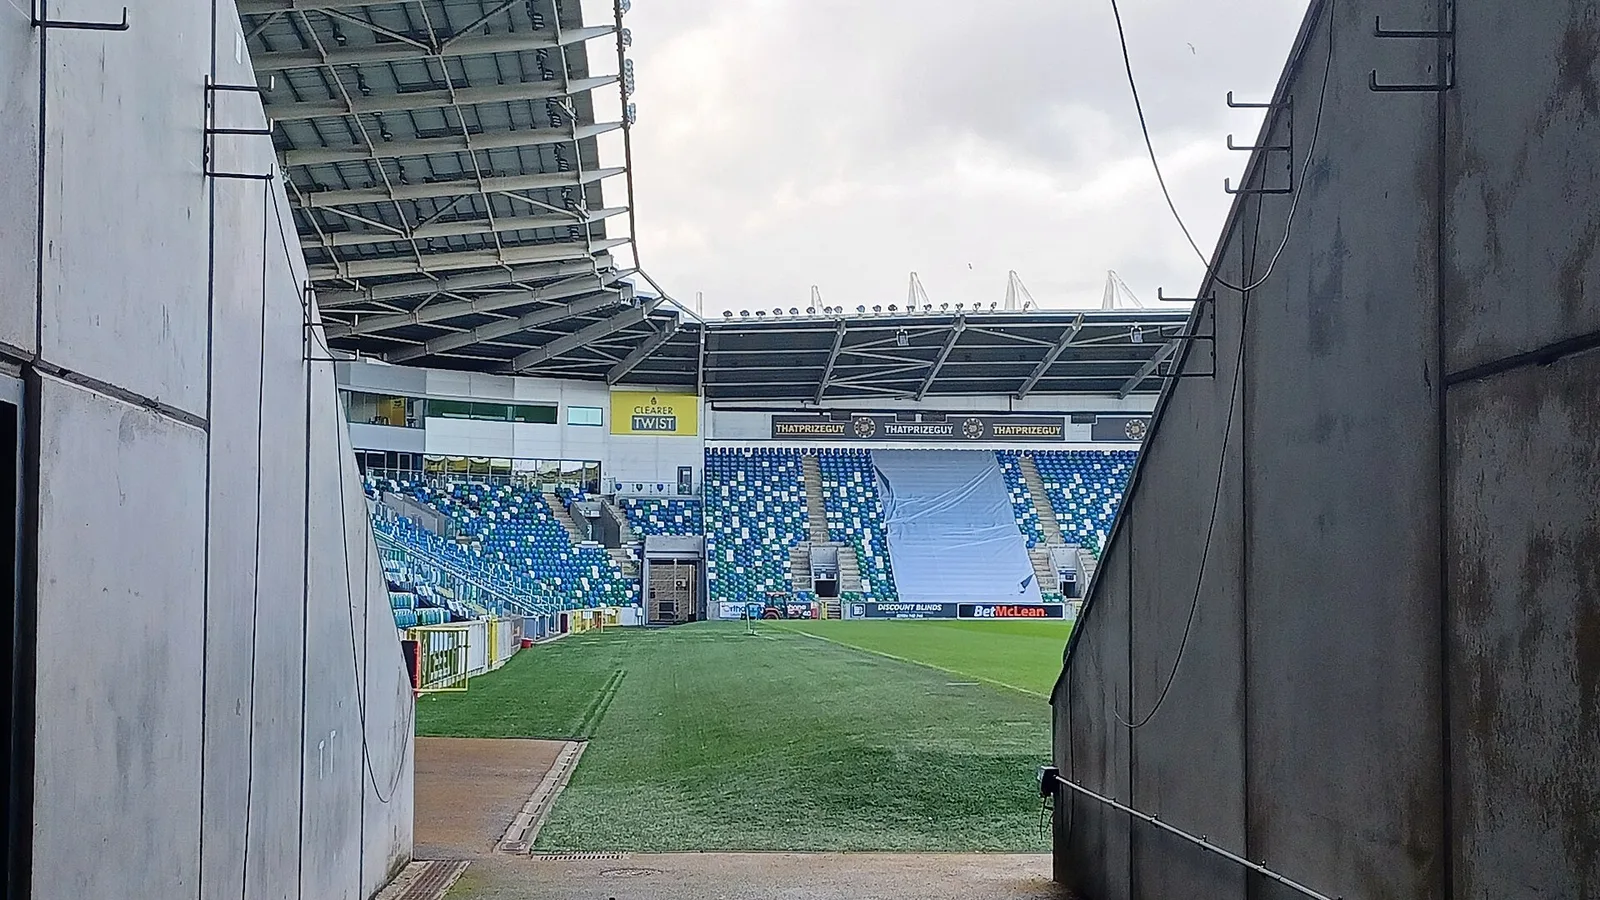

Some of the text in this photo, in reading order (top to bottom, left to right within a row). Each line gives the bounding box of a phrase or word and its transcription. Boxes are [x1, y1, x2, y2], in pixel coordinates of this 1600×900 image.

[634, 406, 673, 415] CLEARER
[634, 417, 674, 429] TWIST
[776, 424, 845, 433] THATPRIZEGUY
[885, 425, 953, 434] THATPRIZEGUY
[993, 426, 1062, 435] THATPRIZEGUY
